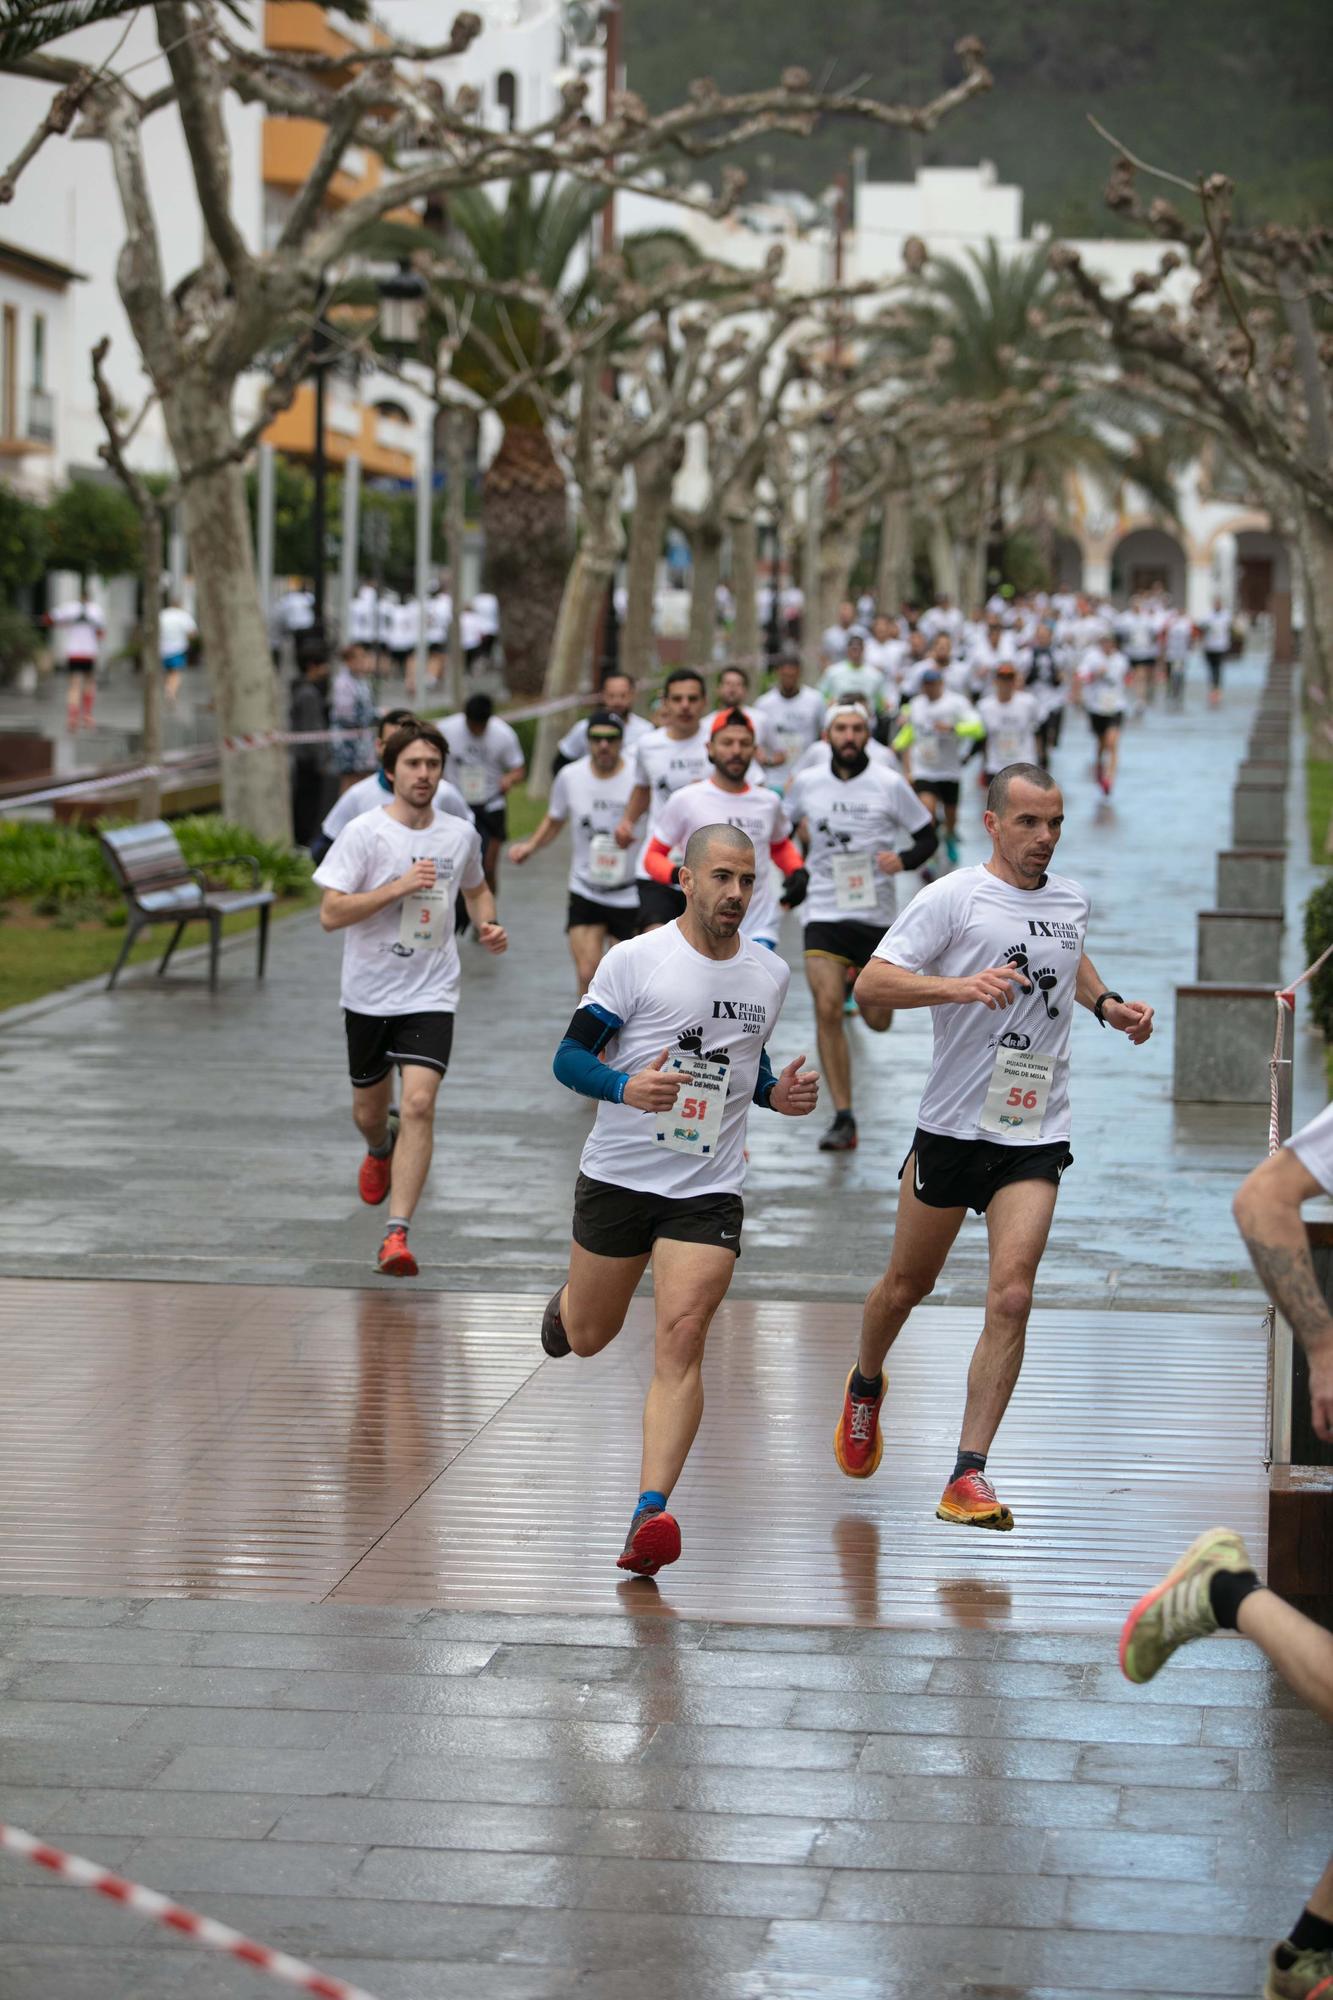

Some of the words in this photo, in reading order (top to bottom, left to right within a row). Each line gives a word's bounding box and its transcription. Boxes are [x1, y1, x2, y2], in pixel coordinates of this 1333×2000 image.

[420, 909, 430, 924] 3
[1028, 921, 1053, 937] IX
[1052, 922, 1077, 931] PUJADA
[1053, 930, 1078, 940] EXTREM
[1060, 940, 1076, 950] 2023
[712, 1000, 738, 1019] IX
[739, 1002, 765, 1014] PUJADA
[738, 1011, 765, 1024] EXTREM
[742, 1022, 761, 1034] 2023
[692, 1061, 707, 1070] 2023
[1028, 1063, 1049, 1071] EXTREM
[702, 1073, 724, 1082] EXTREM
[1004, 1068, 1020, 1076] PUIG
[1006, 1087, 1037, 1110] 56
[680, 1096, 708, 1121] 51
